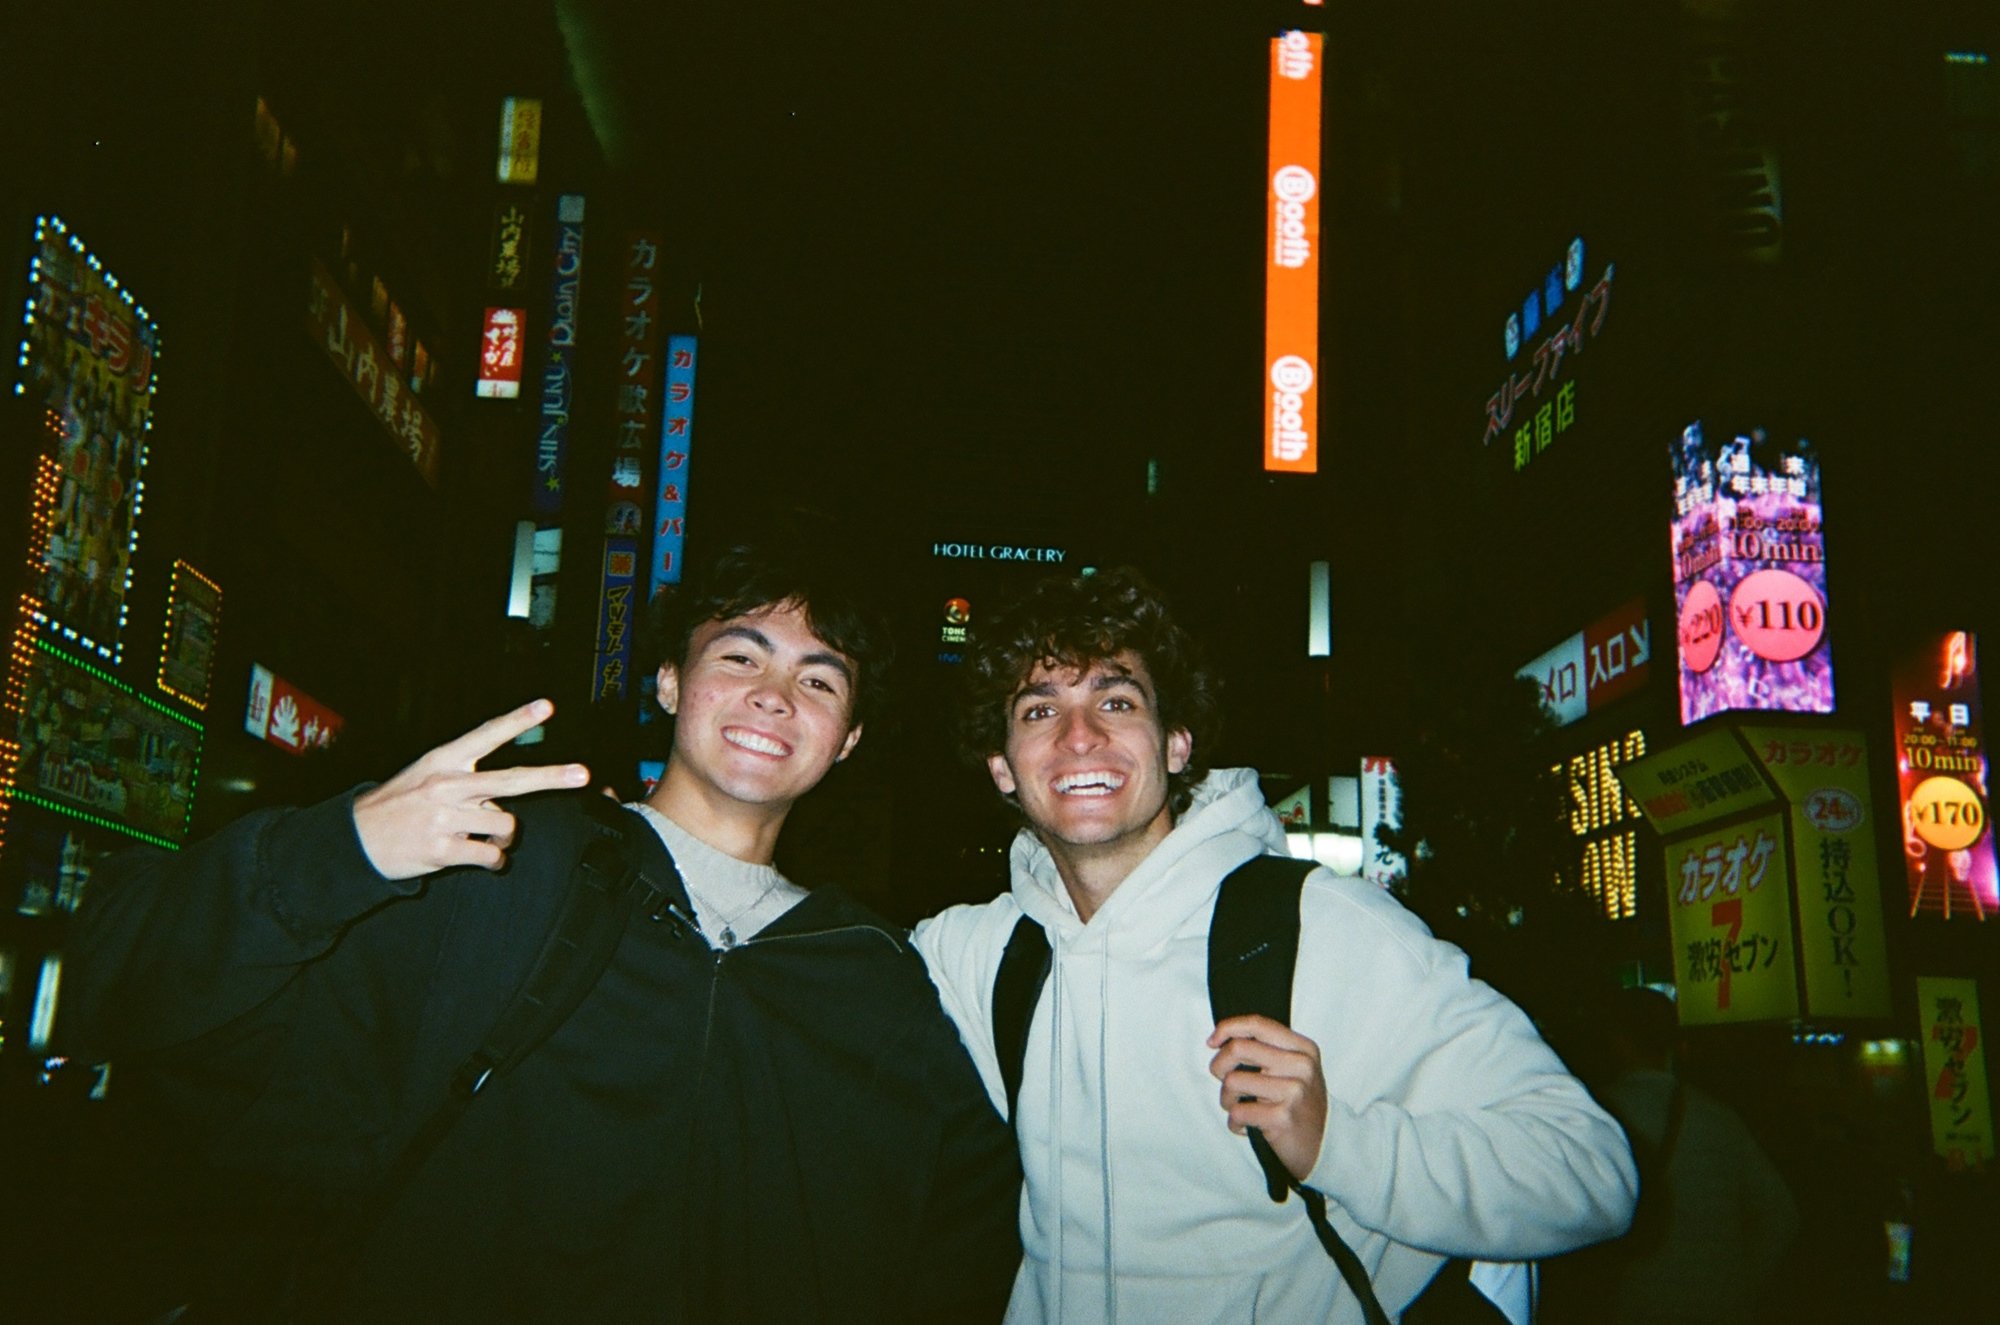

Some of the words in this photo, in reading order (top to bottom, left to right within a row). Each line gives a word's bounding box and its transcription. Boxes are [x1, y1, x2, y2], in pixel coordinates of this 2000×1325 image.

[1272, 165, 1316, 268] Booth
[1271, 355, 1314, 461] Booth
[1514, 378, 1576, 473] 新宿店
[933, 543, 985, 558] HOTEL
[990, 546, 1067, 562] GRACERY
[1735, 601, 1819, 630] ¥110
[1764, 740, 1862, 767] カラオケ
[1906, 746, 1979, 770] 10min
[1678, 828, 1776, 906] カラオケ
[1711, 899, 1743, 1009] 7
[1820, 838, 1858, 999] 持込OK!
